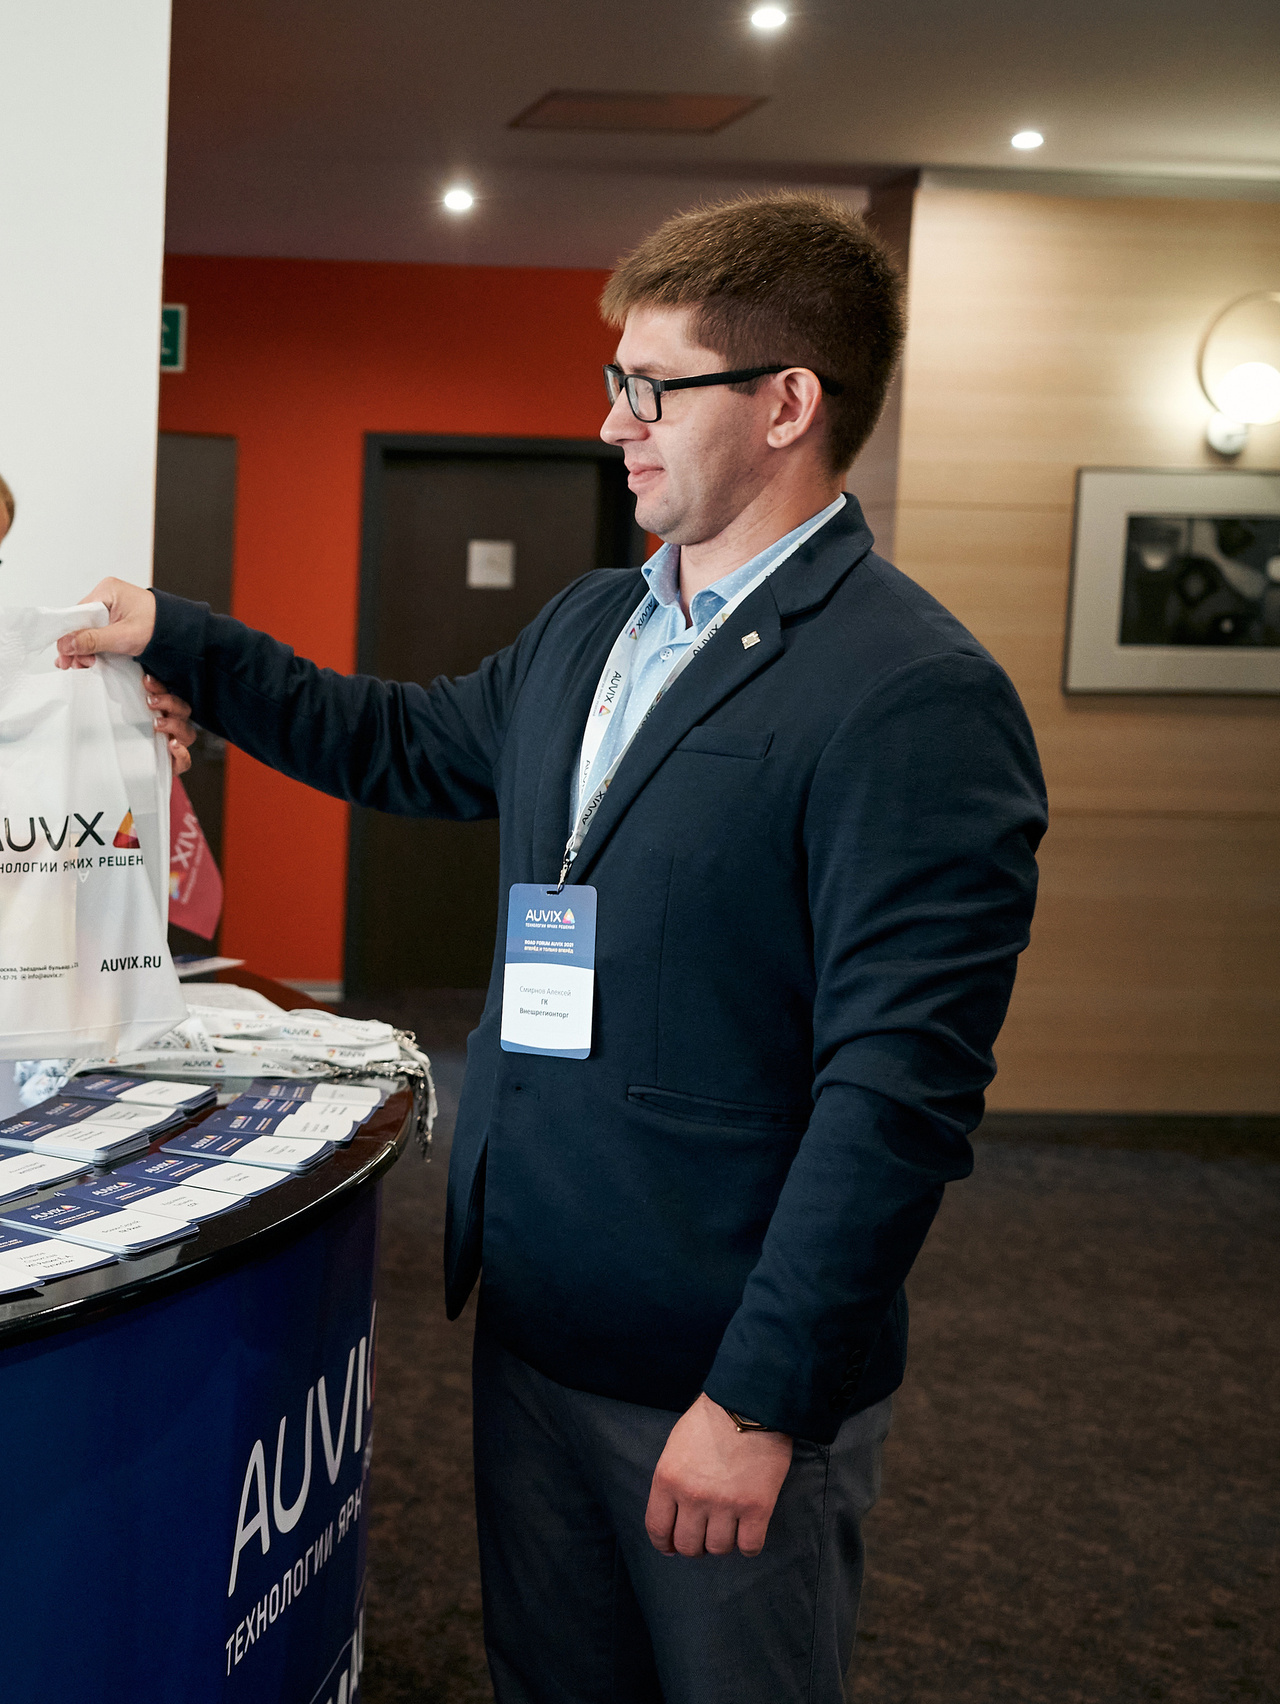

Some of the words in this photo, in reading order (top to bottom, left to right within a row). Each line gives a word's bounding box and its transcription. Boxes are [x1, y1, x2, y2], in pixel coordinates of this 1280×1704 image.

[636, 598, 653, 630] AUVIX
[604, 670, 622, 703] AUVIX
[582, 790, 606, 825] AUVIX
[525, 908, 562, 923] AUVIX
[100, 955, 162, 973] AUVIX.RU
[519, 985, 546, 995] Смирнов
[546, 988, 572, 997] Алексей
[540, 998, 549, 1006] ГК
[519, 1007, 569, 1019] Внешрегионторг
[282, 1027, 311, 1036] AUVIX
[182, 1059, 213, 1068] AUVIX
[145, 1161, 170, 1174] AUVIX
[92, 1184, 119, 1196] AUVIX
[31, 1207, 65, 1220] AUVIX
[225, 1521, 334, 1677] ТЕХНОЛОГИИ
